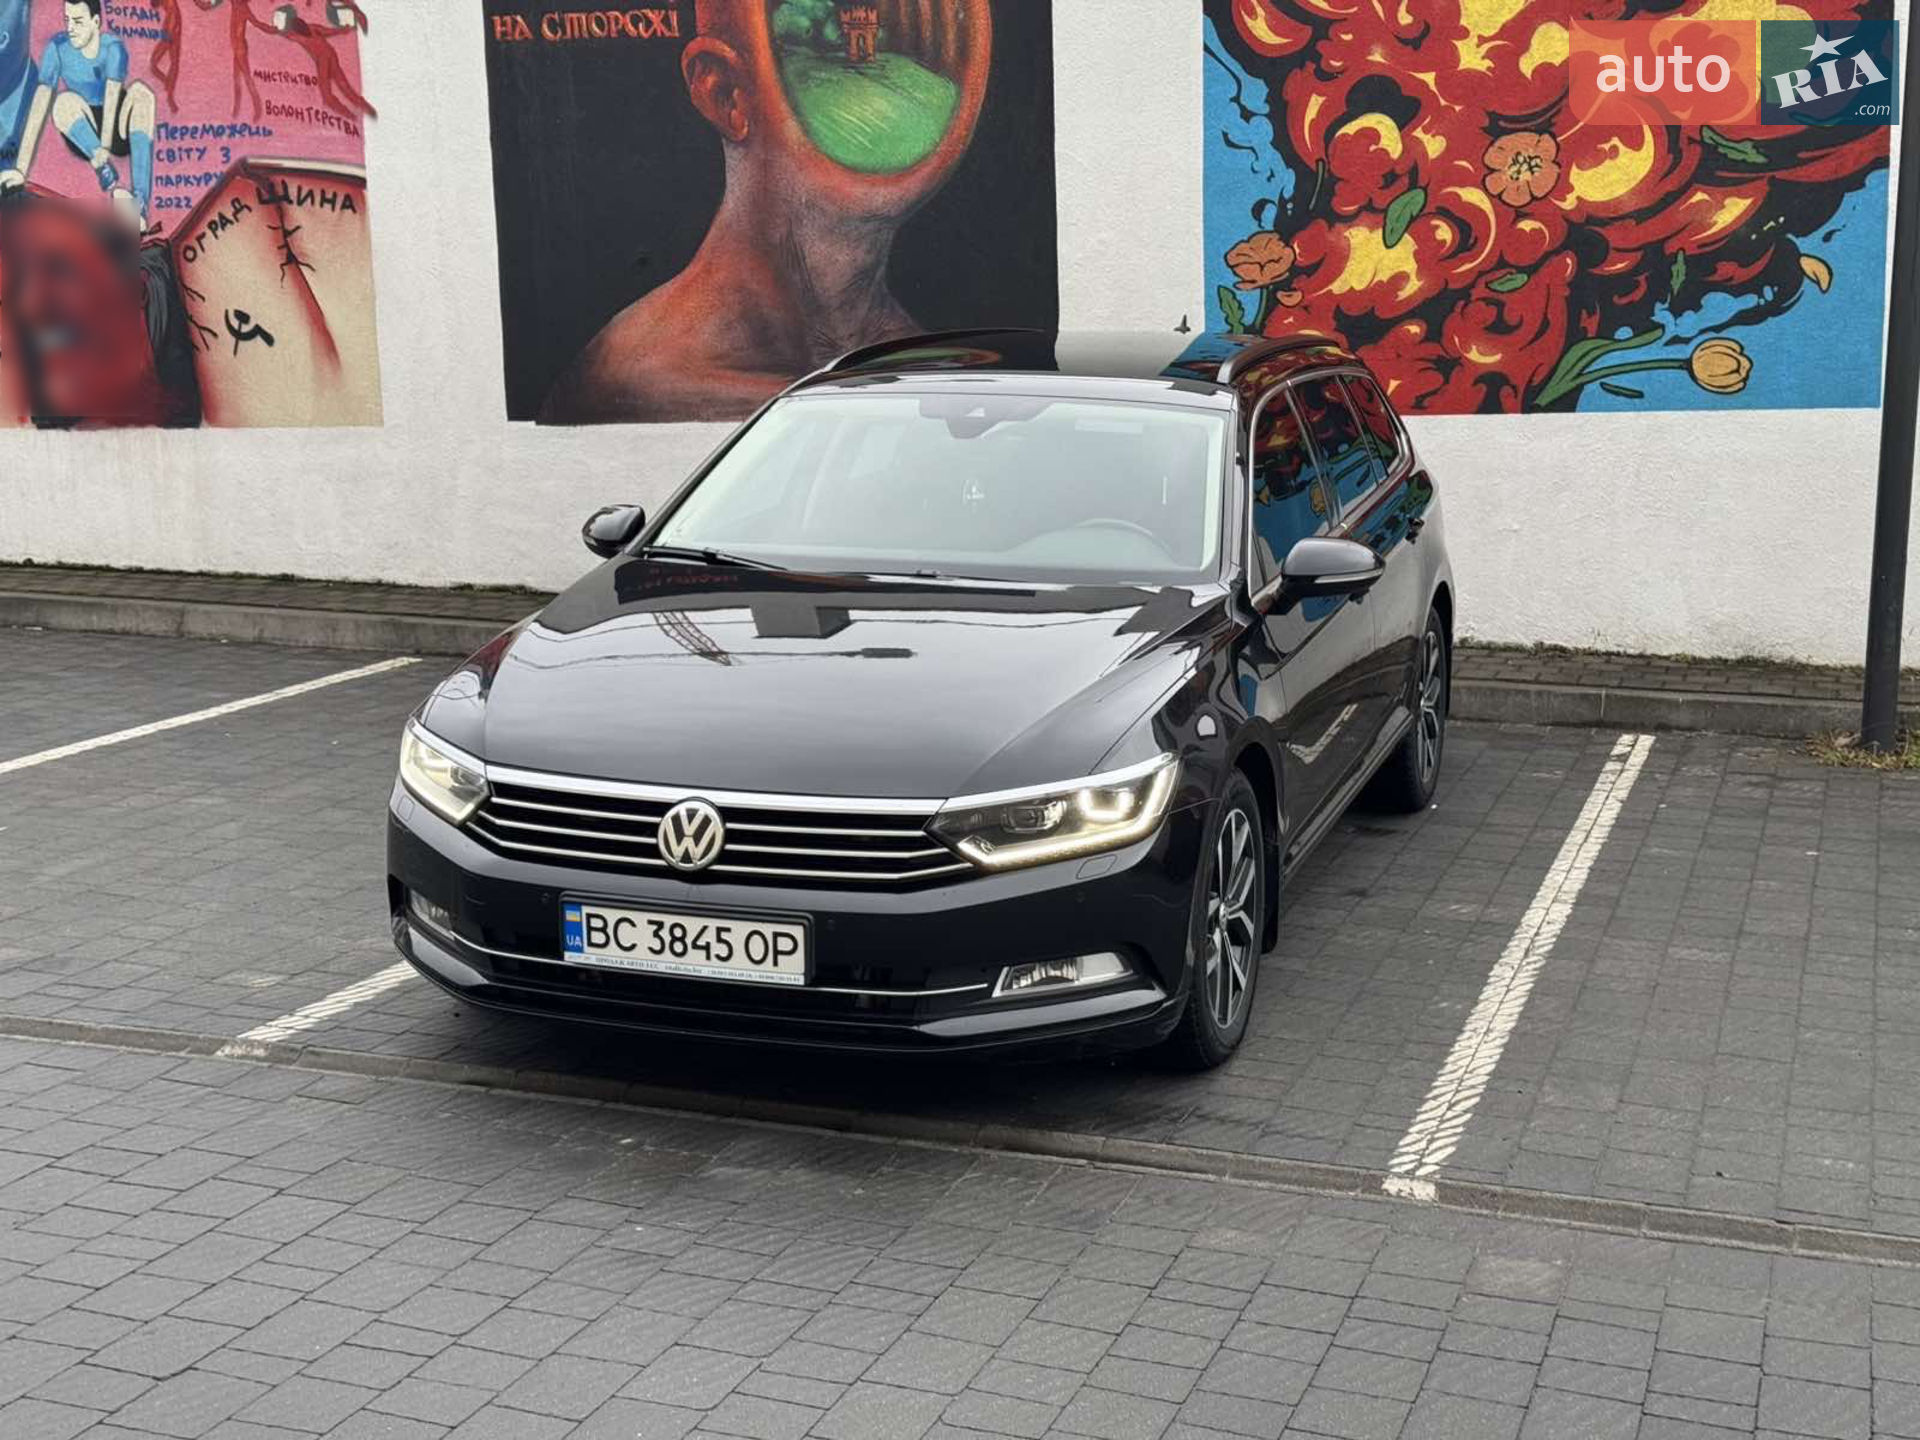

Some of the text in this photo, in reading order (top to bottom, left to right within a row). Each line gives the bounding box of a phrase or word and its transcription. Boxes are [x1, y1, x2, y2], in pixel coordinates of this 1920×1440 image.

[491, 14, 533, 40] НА
[154, 196, 193, 209] 2022
[565, 934, 583, 948] UA
[585, 912, 799, 967] BC 3845 OP
